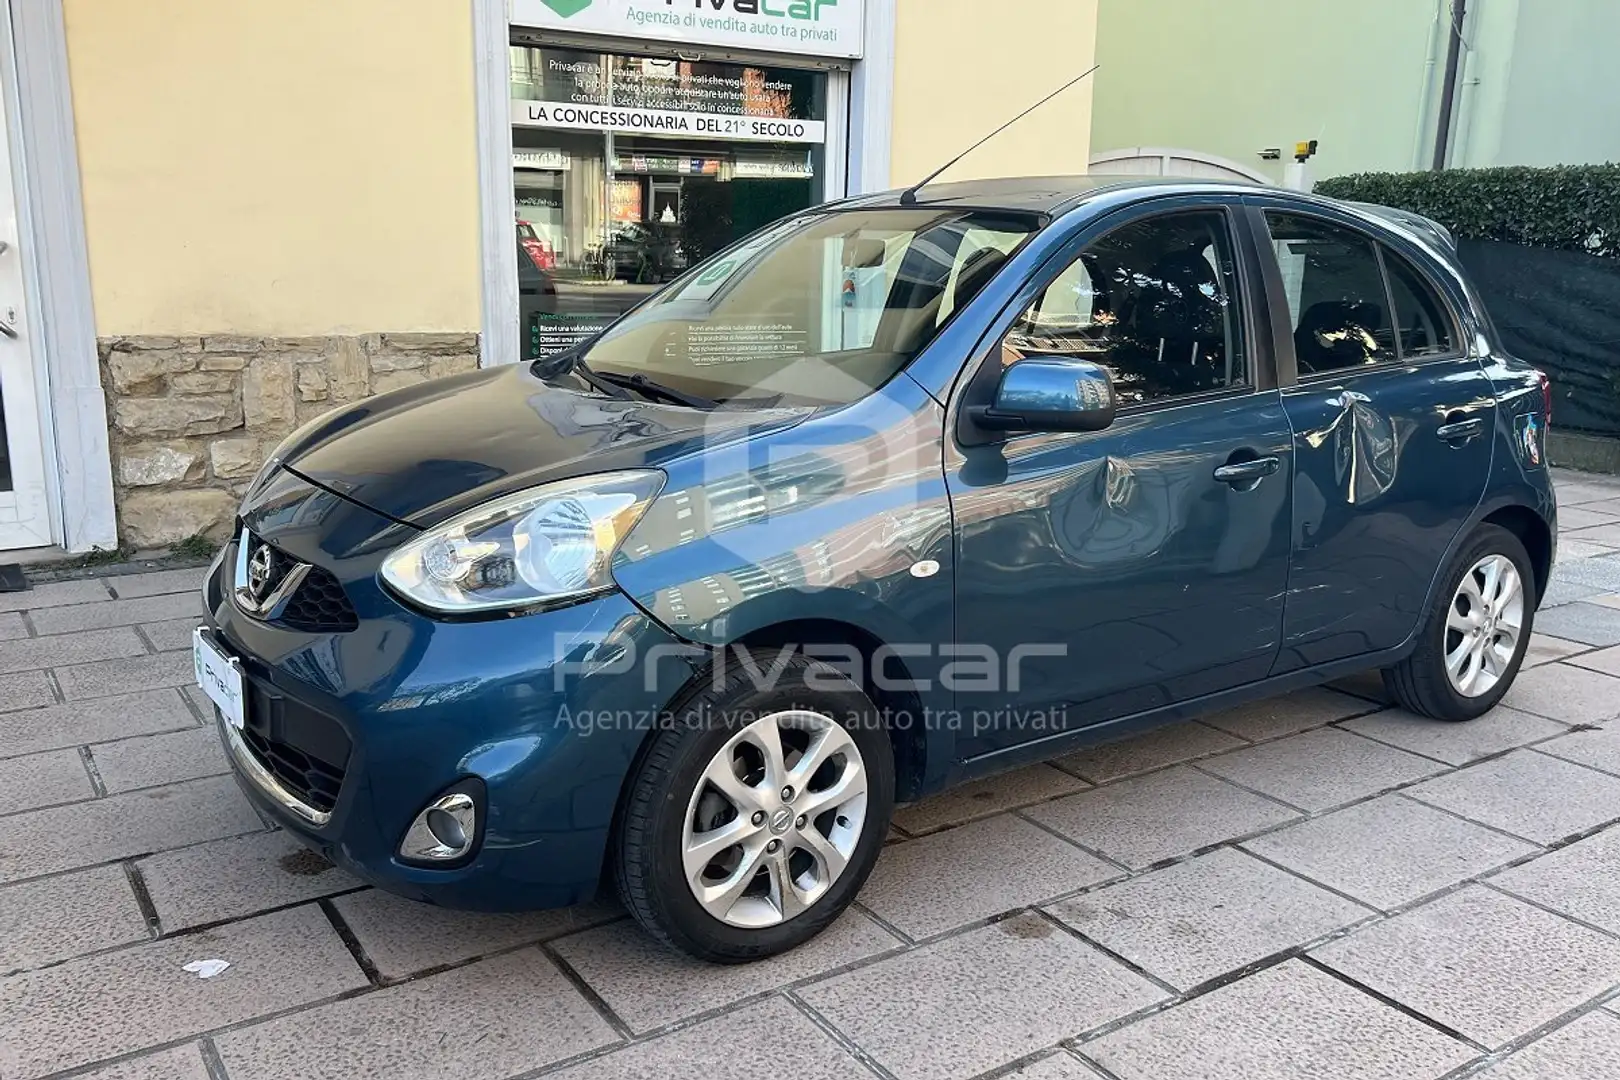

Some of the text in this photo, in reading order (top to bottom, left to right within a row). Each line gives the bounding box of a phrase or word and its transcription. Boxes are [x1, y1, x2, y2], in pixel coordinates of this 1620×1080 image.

[626, 6, 837, 41] Agenzia di vendita auto tra privati
[549, 59, 586, 73] Privacar
[571, 93, 589, 102] con
[528, 105, 805, 137] LA CONCESSIONARIA DEL 21° SECOLO
